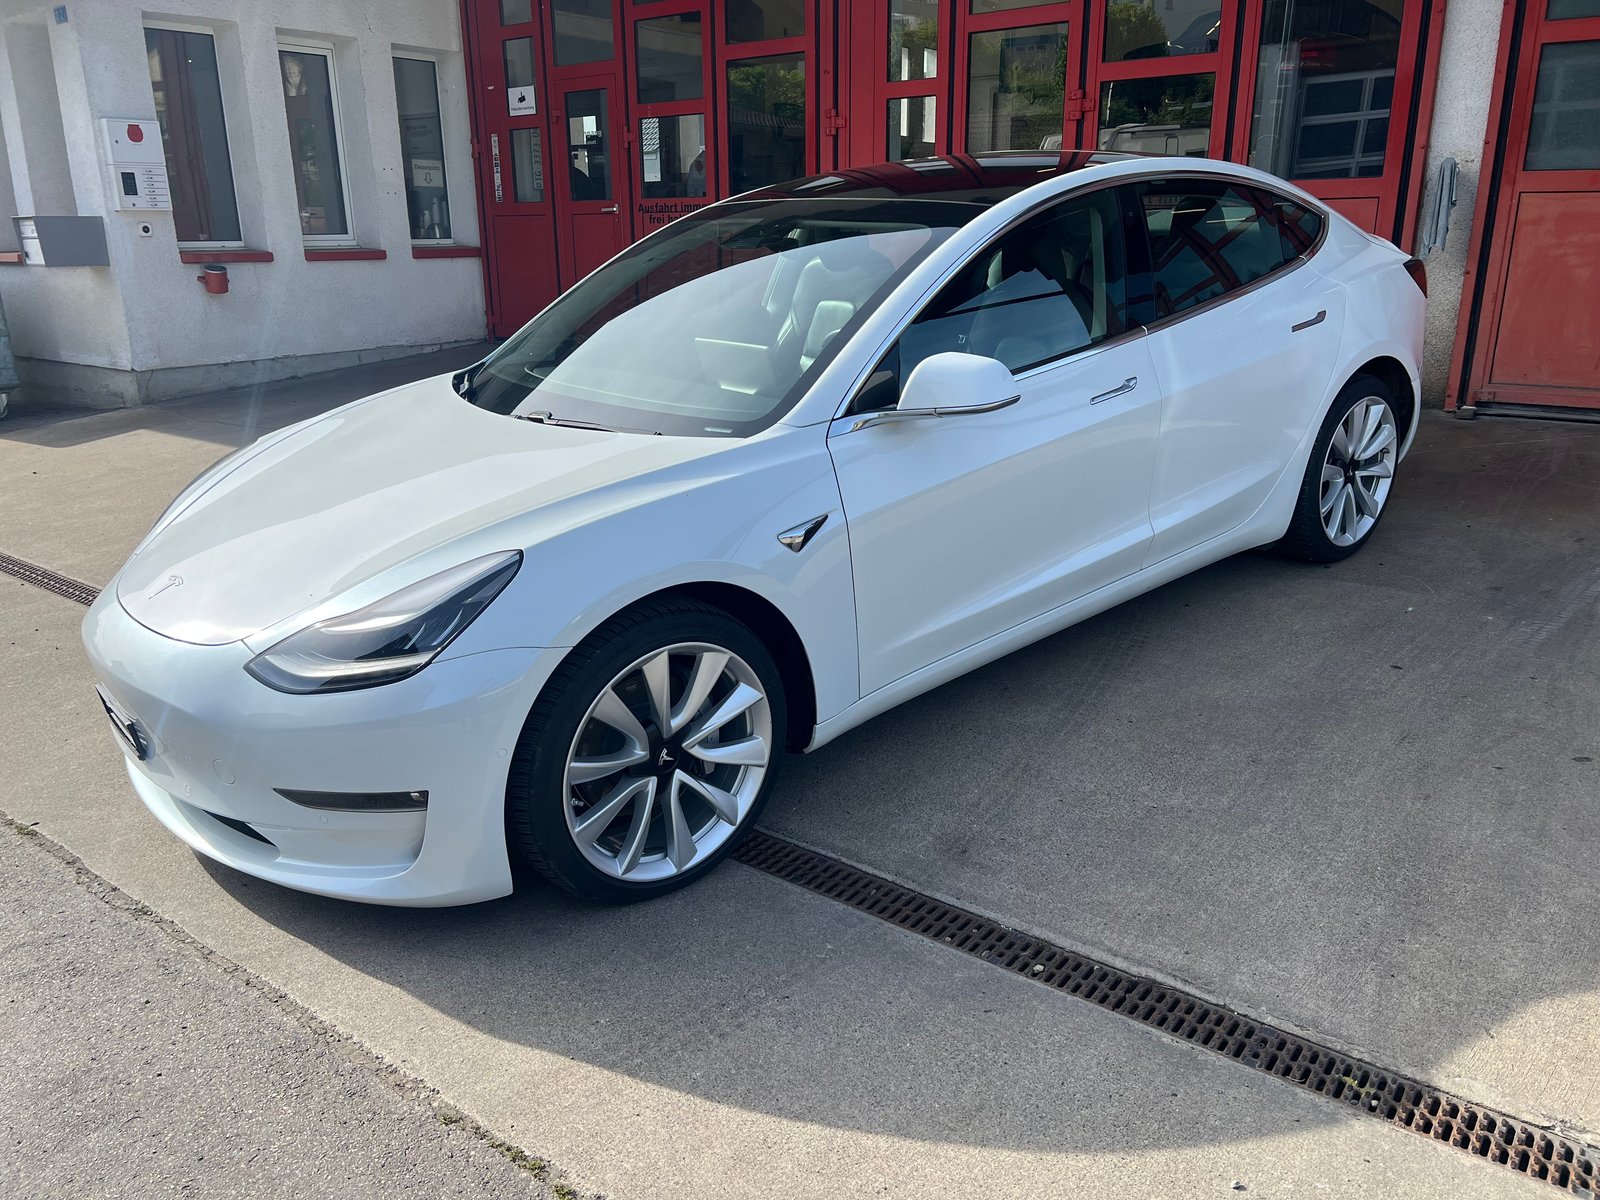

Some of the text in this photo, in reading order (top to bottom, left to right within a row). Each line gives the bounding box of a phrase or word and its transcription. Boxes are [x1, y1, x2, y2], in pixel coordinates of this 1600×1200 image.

[638, 202, 706, 213] Ausfahrt imme
[650, 214, 665, 224] frei
